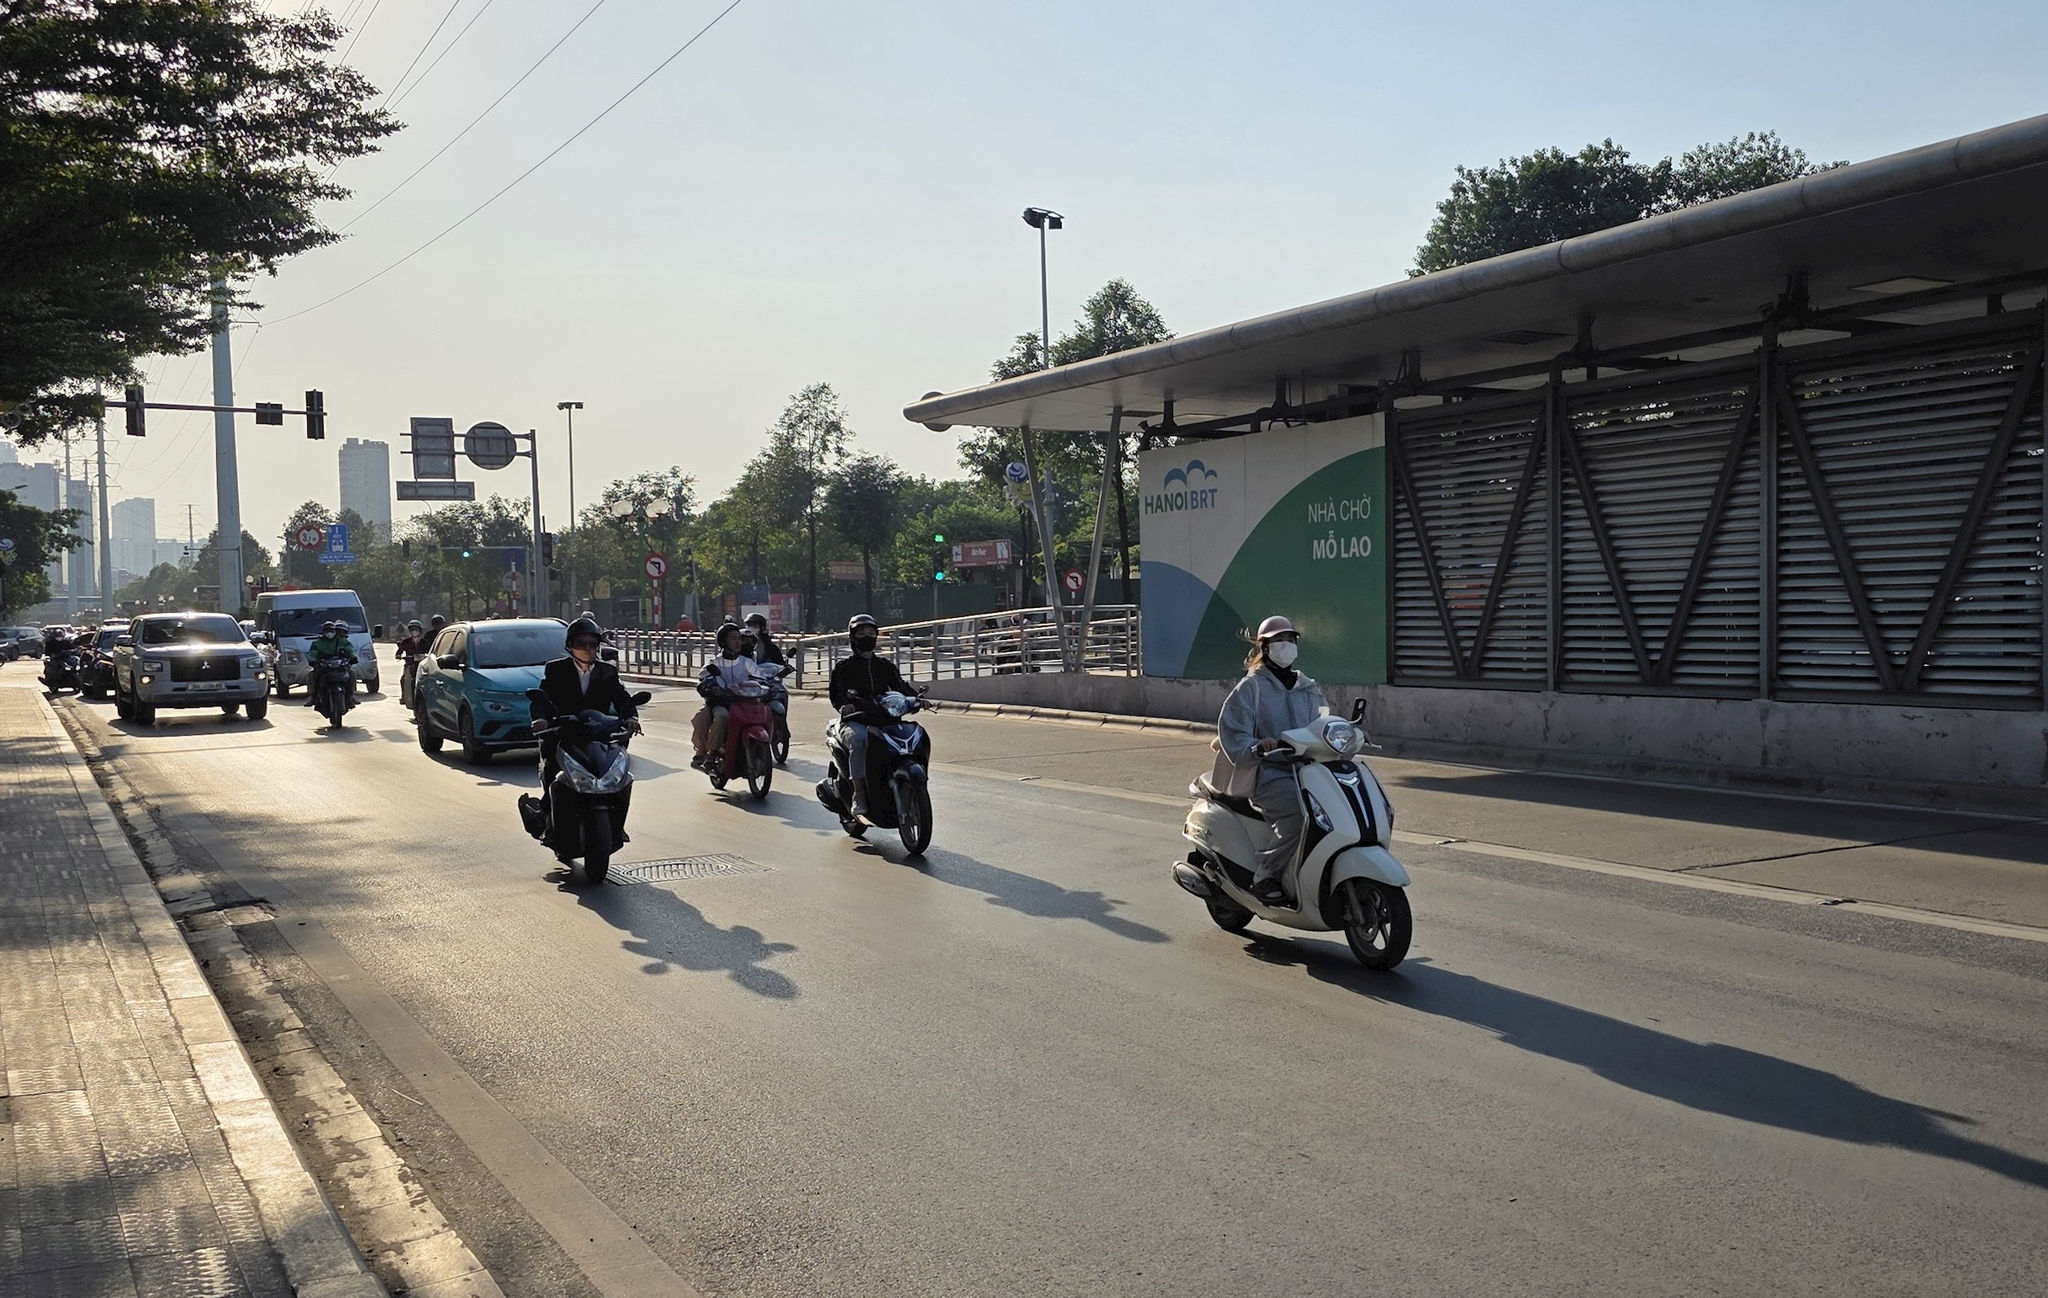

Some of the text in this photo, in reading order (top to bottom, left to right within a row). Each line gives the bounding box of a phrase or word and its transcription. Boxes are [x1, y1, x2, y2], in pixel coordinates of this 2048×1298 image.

[1144, 488, 1217, 514] HANOI BRT
[1308, 493, 1371, 523] NHÀ CHỜ
[1313, 530, 1371, 560] MỖ LAO
